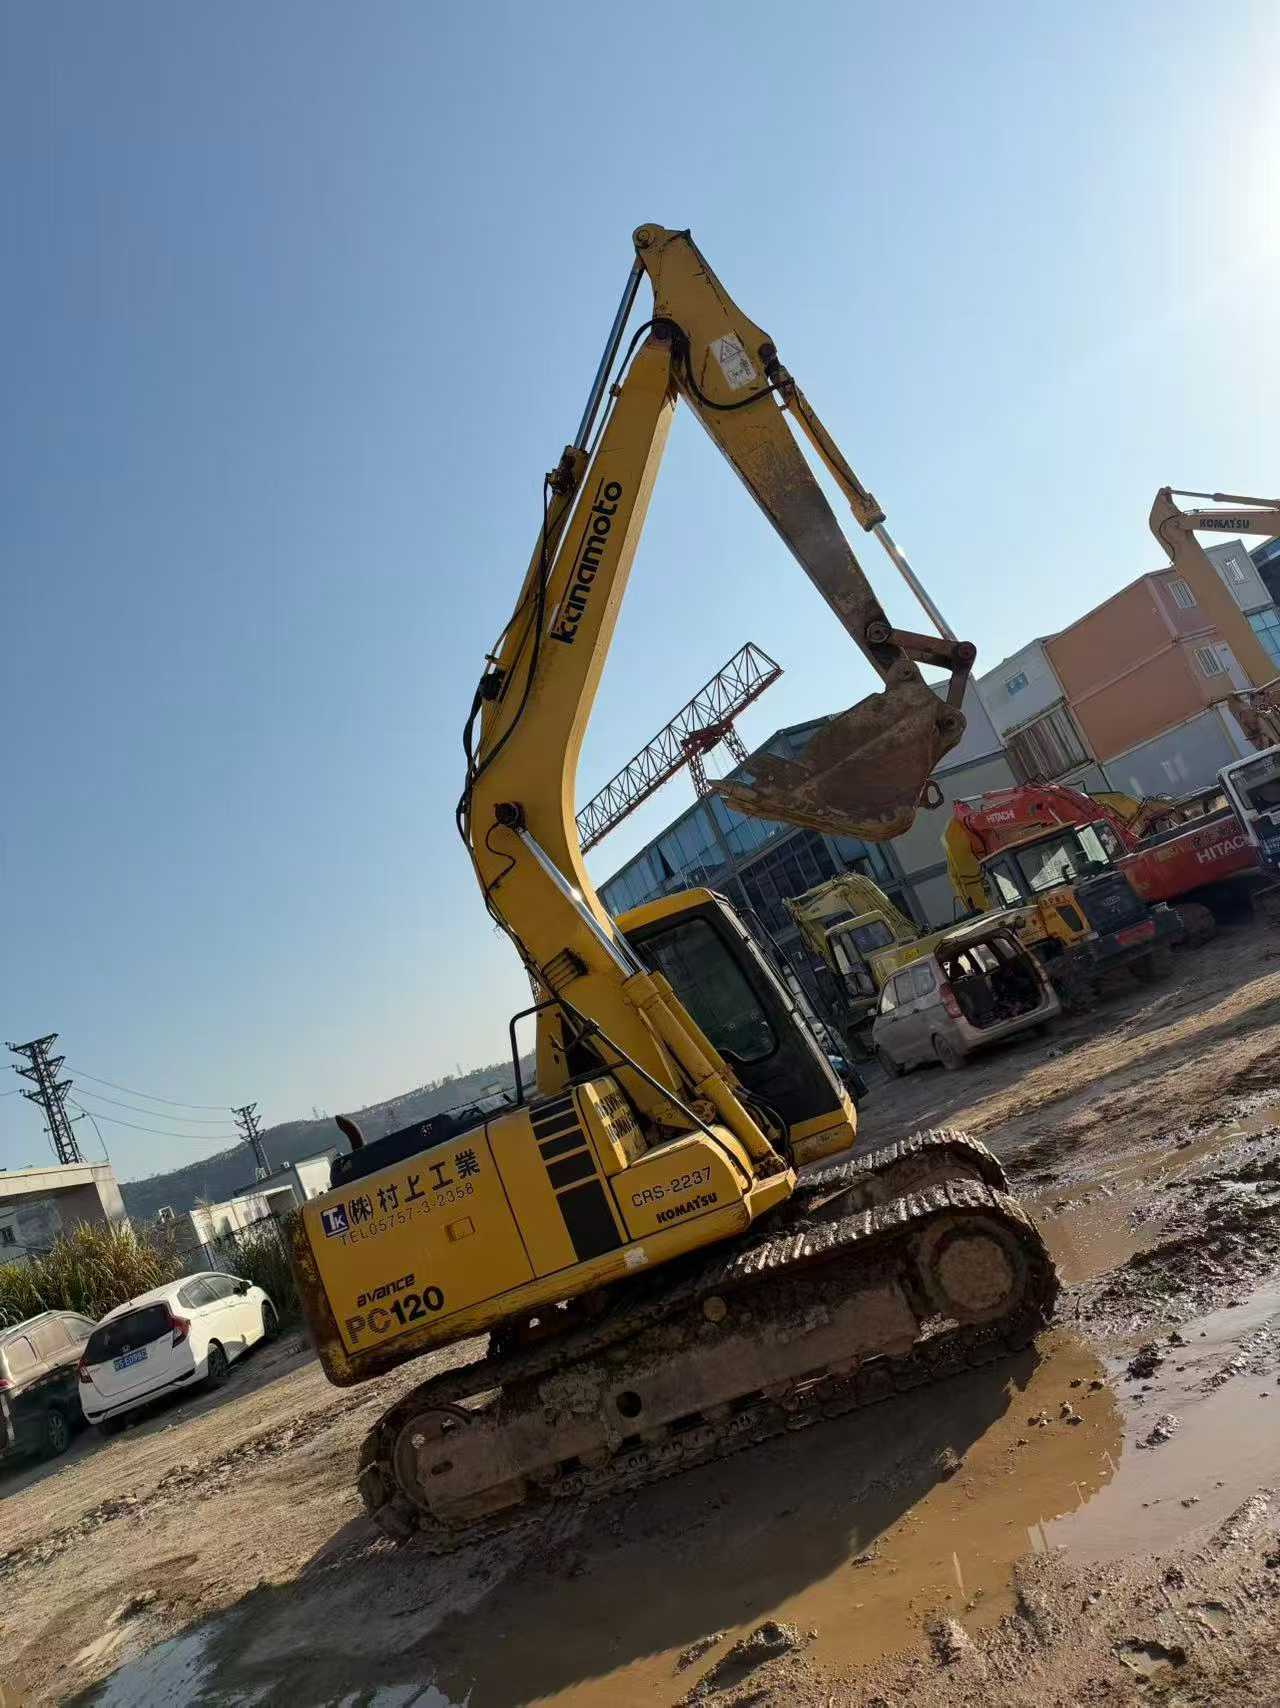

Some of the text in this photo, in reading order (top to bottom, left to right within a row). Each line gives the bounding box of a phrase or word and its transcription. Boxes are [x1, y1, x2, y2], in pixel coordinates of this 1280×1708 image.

[1199, 518, 1250, 529] KOMATSU
[550, 480, 622, 644] kanamoto
[348, 1148, 480, 1225] (株)村上工業
[631, 1166, 713, 1208] CRS-2237
[656, 1192, 718, 1224] KOMATSU
[357, 1273, 417, 1308] avance
[345, 1286, 445, 1345] PC120
